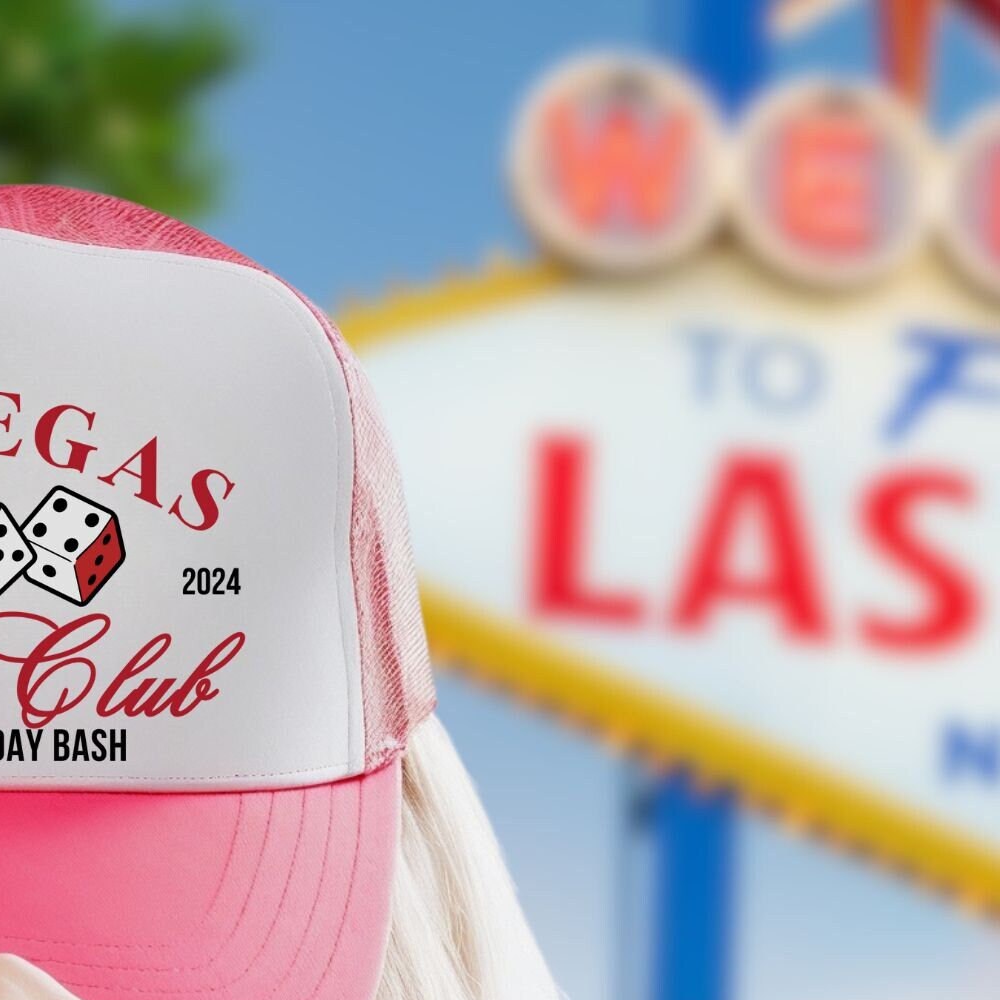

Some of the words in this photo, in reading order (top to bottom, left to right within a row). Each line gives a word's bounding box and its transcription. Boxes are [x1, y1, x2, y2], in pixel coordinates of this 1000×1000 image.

[536, 96, 1000, 268] WE
[677, 326, 828, 412] TO
[181, 566, 243, 597] 2024
[526, 428, 984, 658] LAS
[52, 727, 128, 763] BASH
